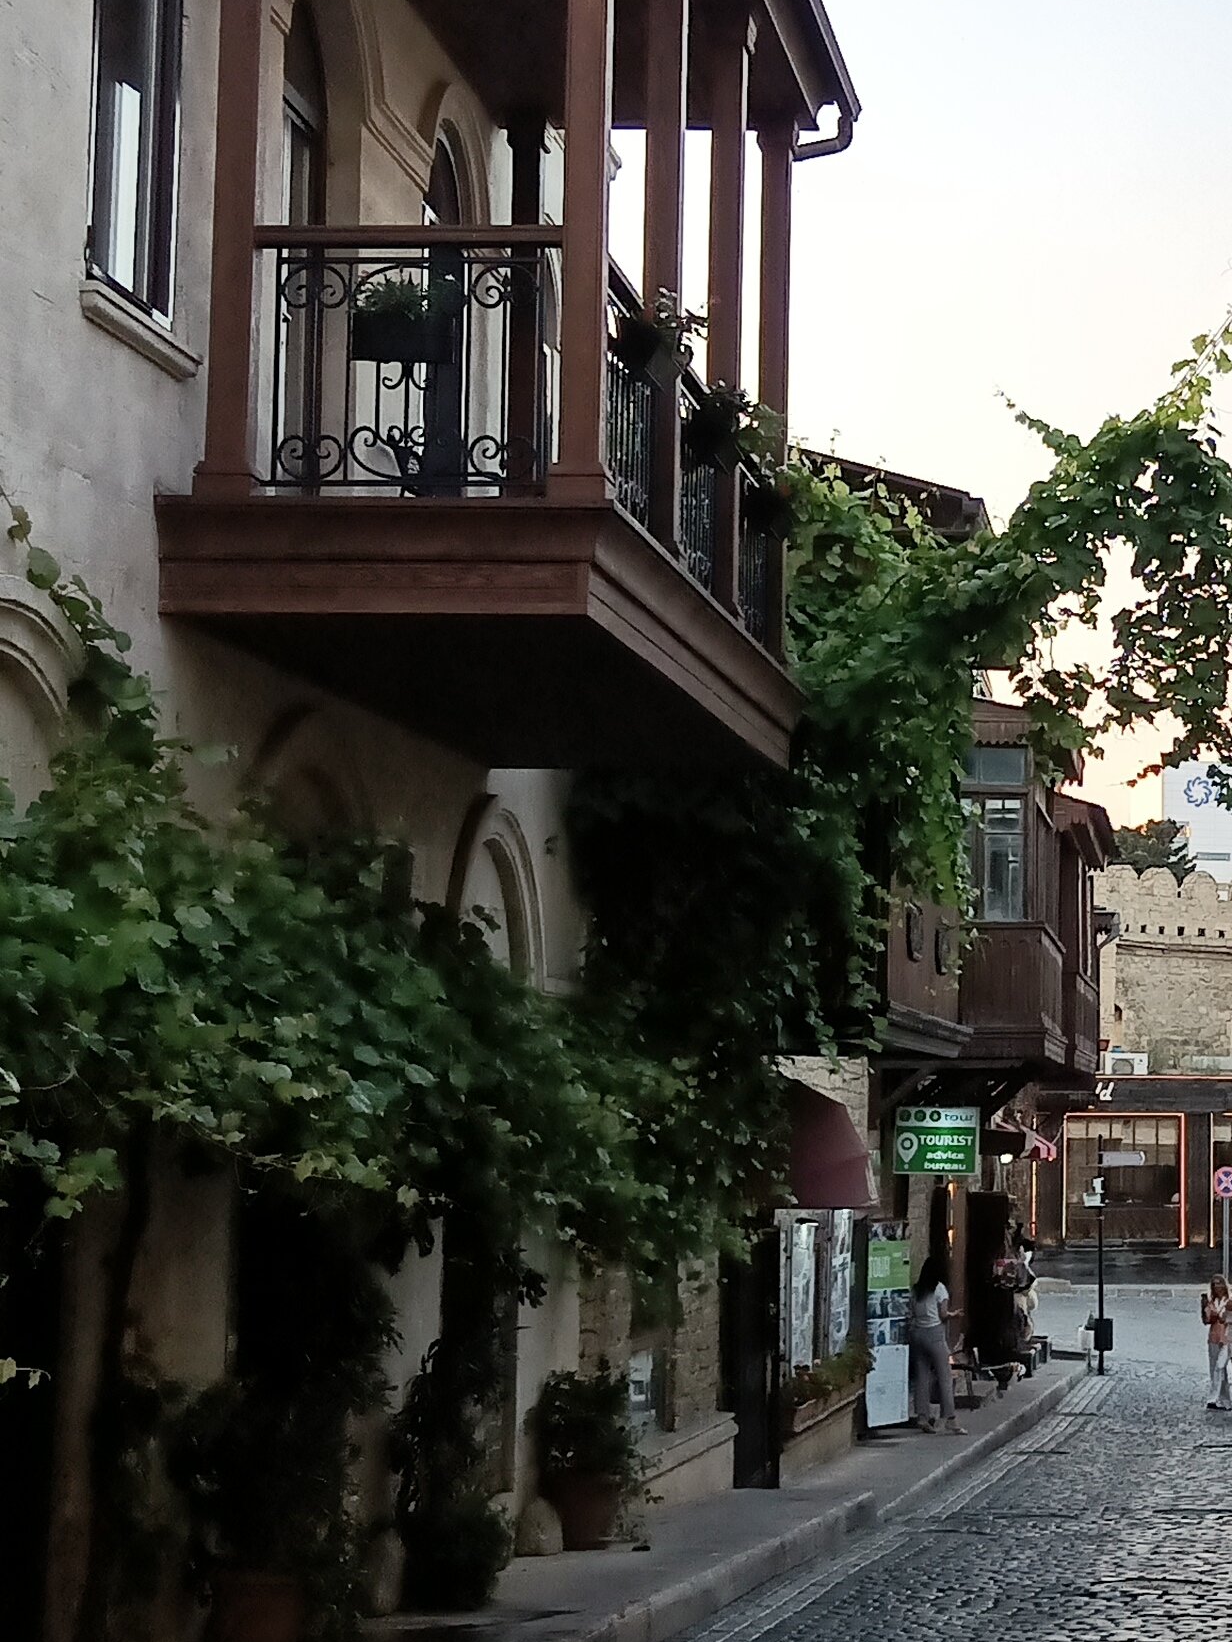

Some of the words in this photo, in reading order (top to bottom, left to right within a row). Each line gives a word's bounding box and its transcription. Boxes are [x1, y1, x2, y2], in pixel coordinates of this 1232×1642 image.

[944, 1113, 974, 1122] tour
[918, 1135, 974, 1146] TOURIST
[926, 1151, 965, 1160] advice
[924, 1161, 966, 1170] bureau
